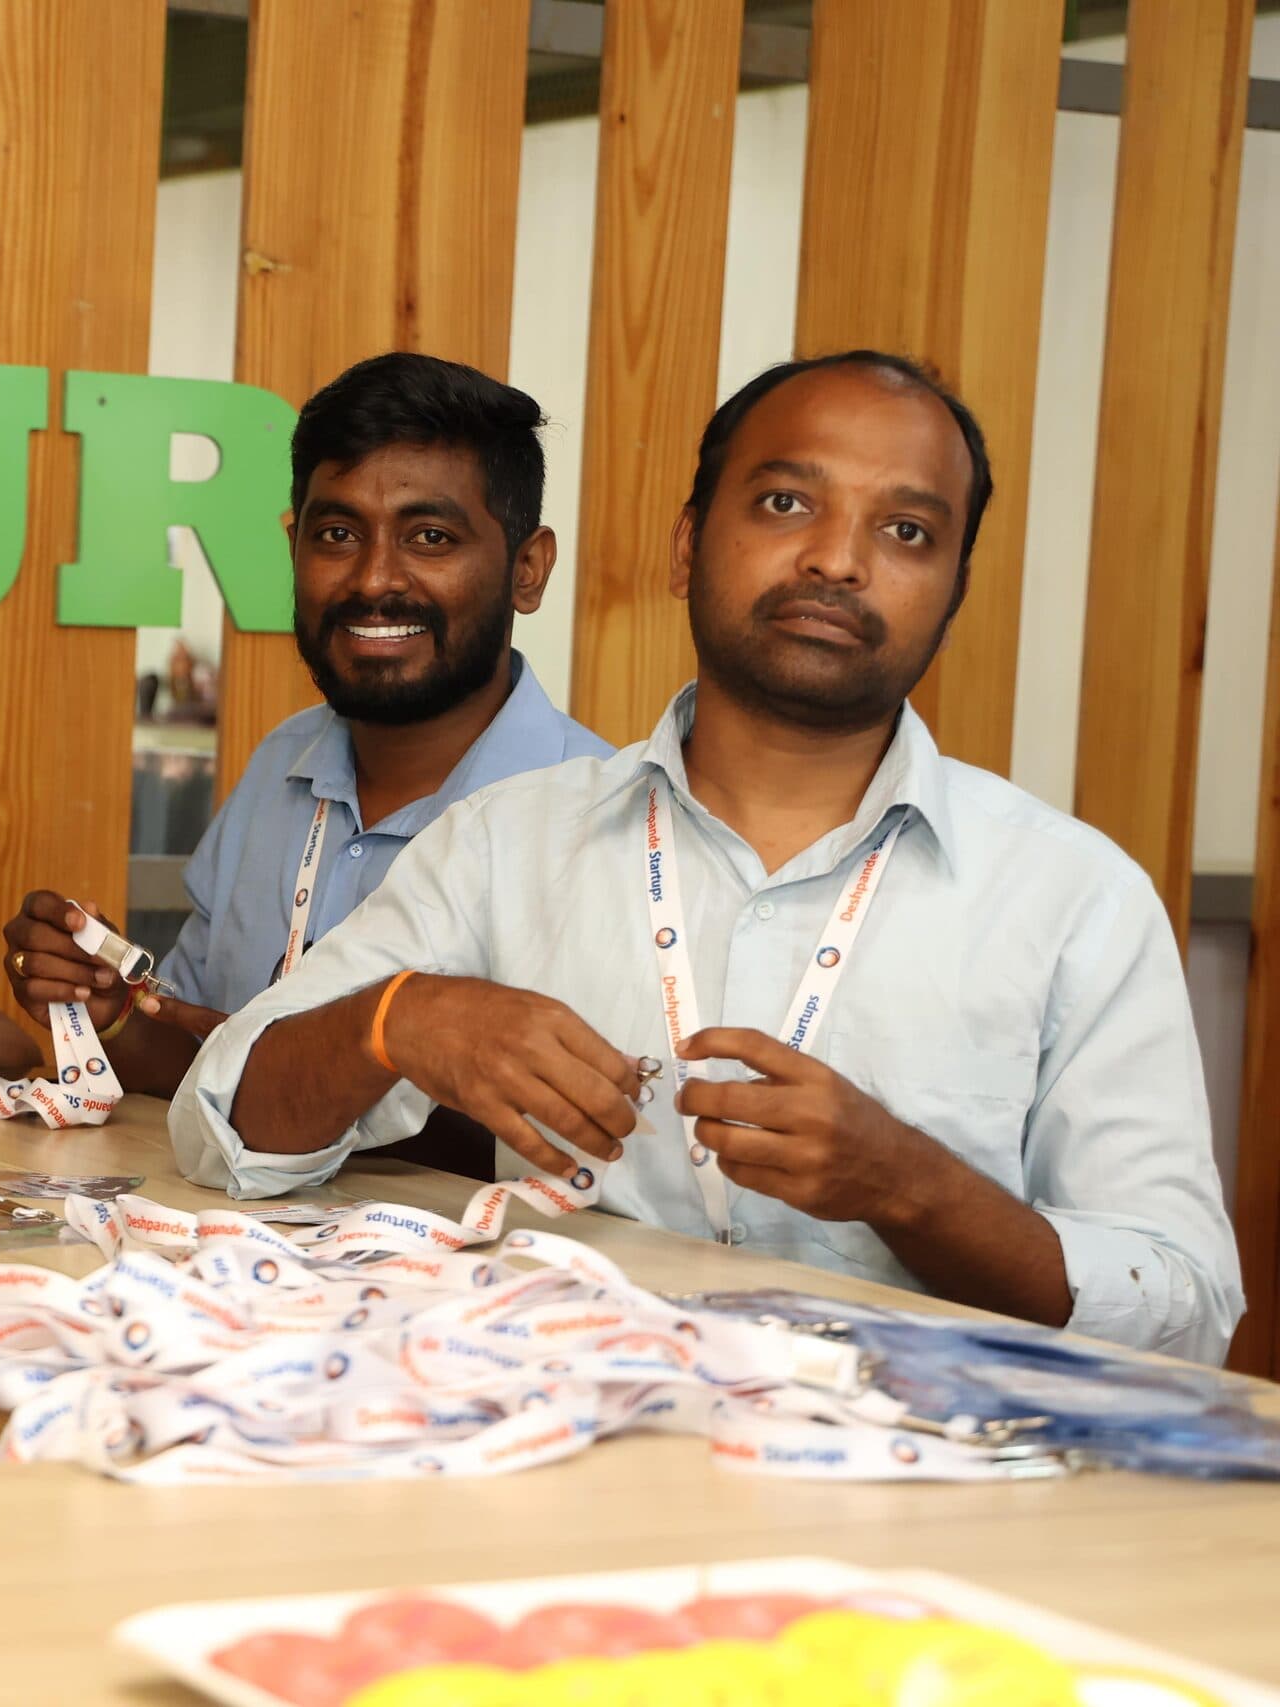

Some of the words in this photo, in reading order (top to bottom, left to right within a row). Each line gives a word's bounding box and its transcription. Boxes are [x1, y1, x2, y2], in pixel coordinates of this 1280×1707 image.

[303, 823, 322, 868] Startups
[648, 850, 662, 902] Startups
[840, 852, 879, 922] Deshpande
[284, 929, 299, 974] Deshpa
[65, 1001, 84, 1037] artups
[786, 994, 820, 1051] Startups
[31, 1087, 68, 1128] Deshpan
[125, 1213, 189, 1237] Deshpande
[364, 1210, 429, 1238] Startups
